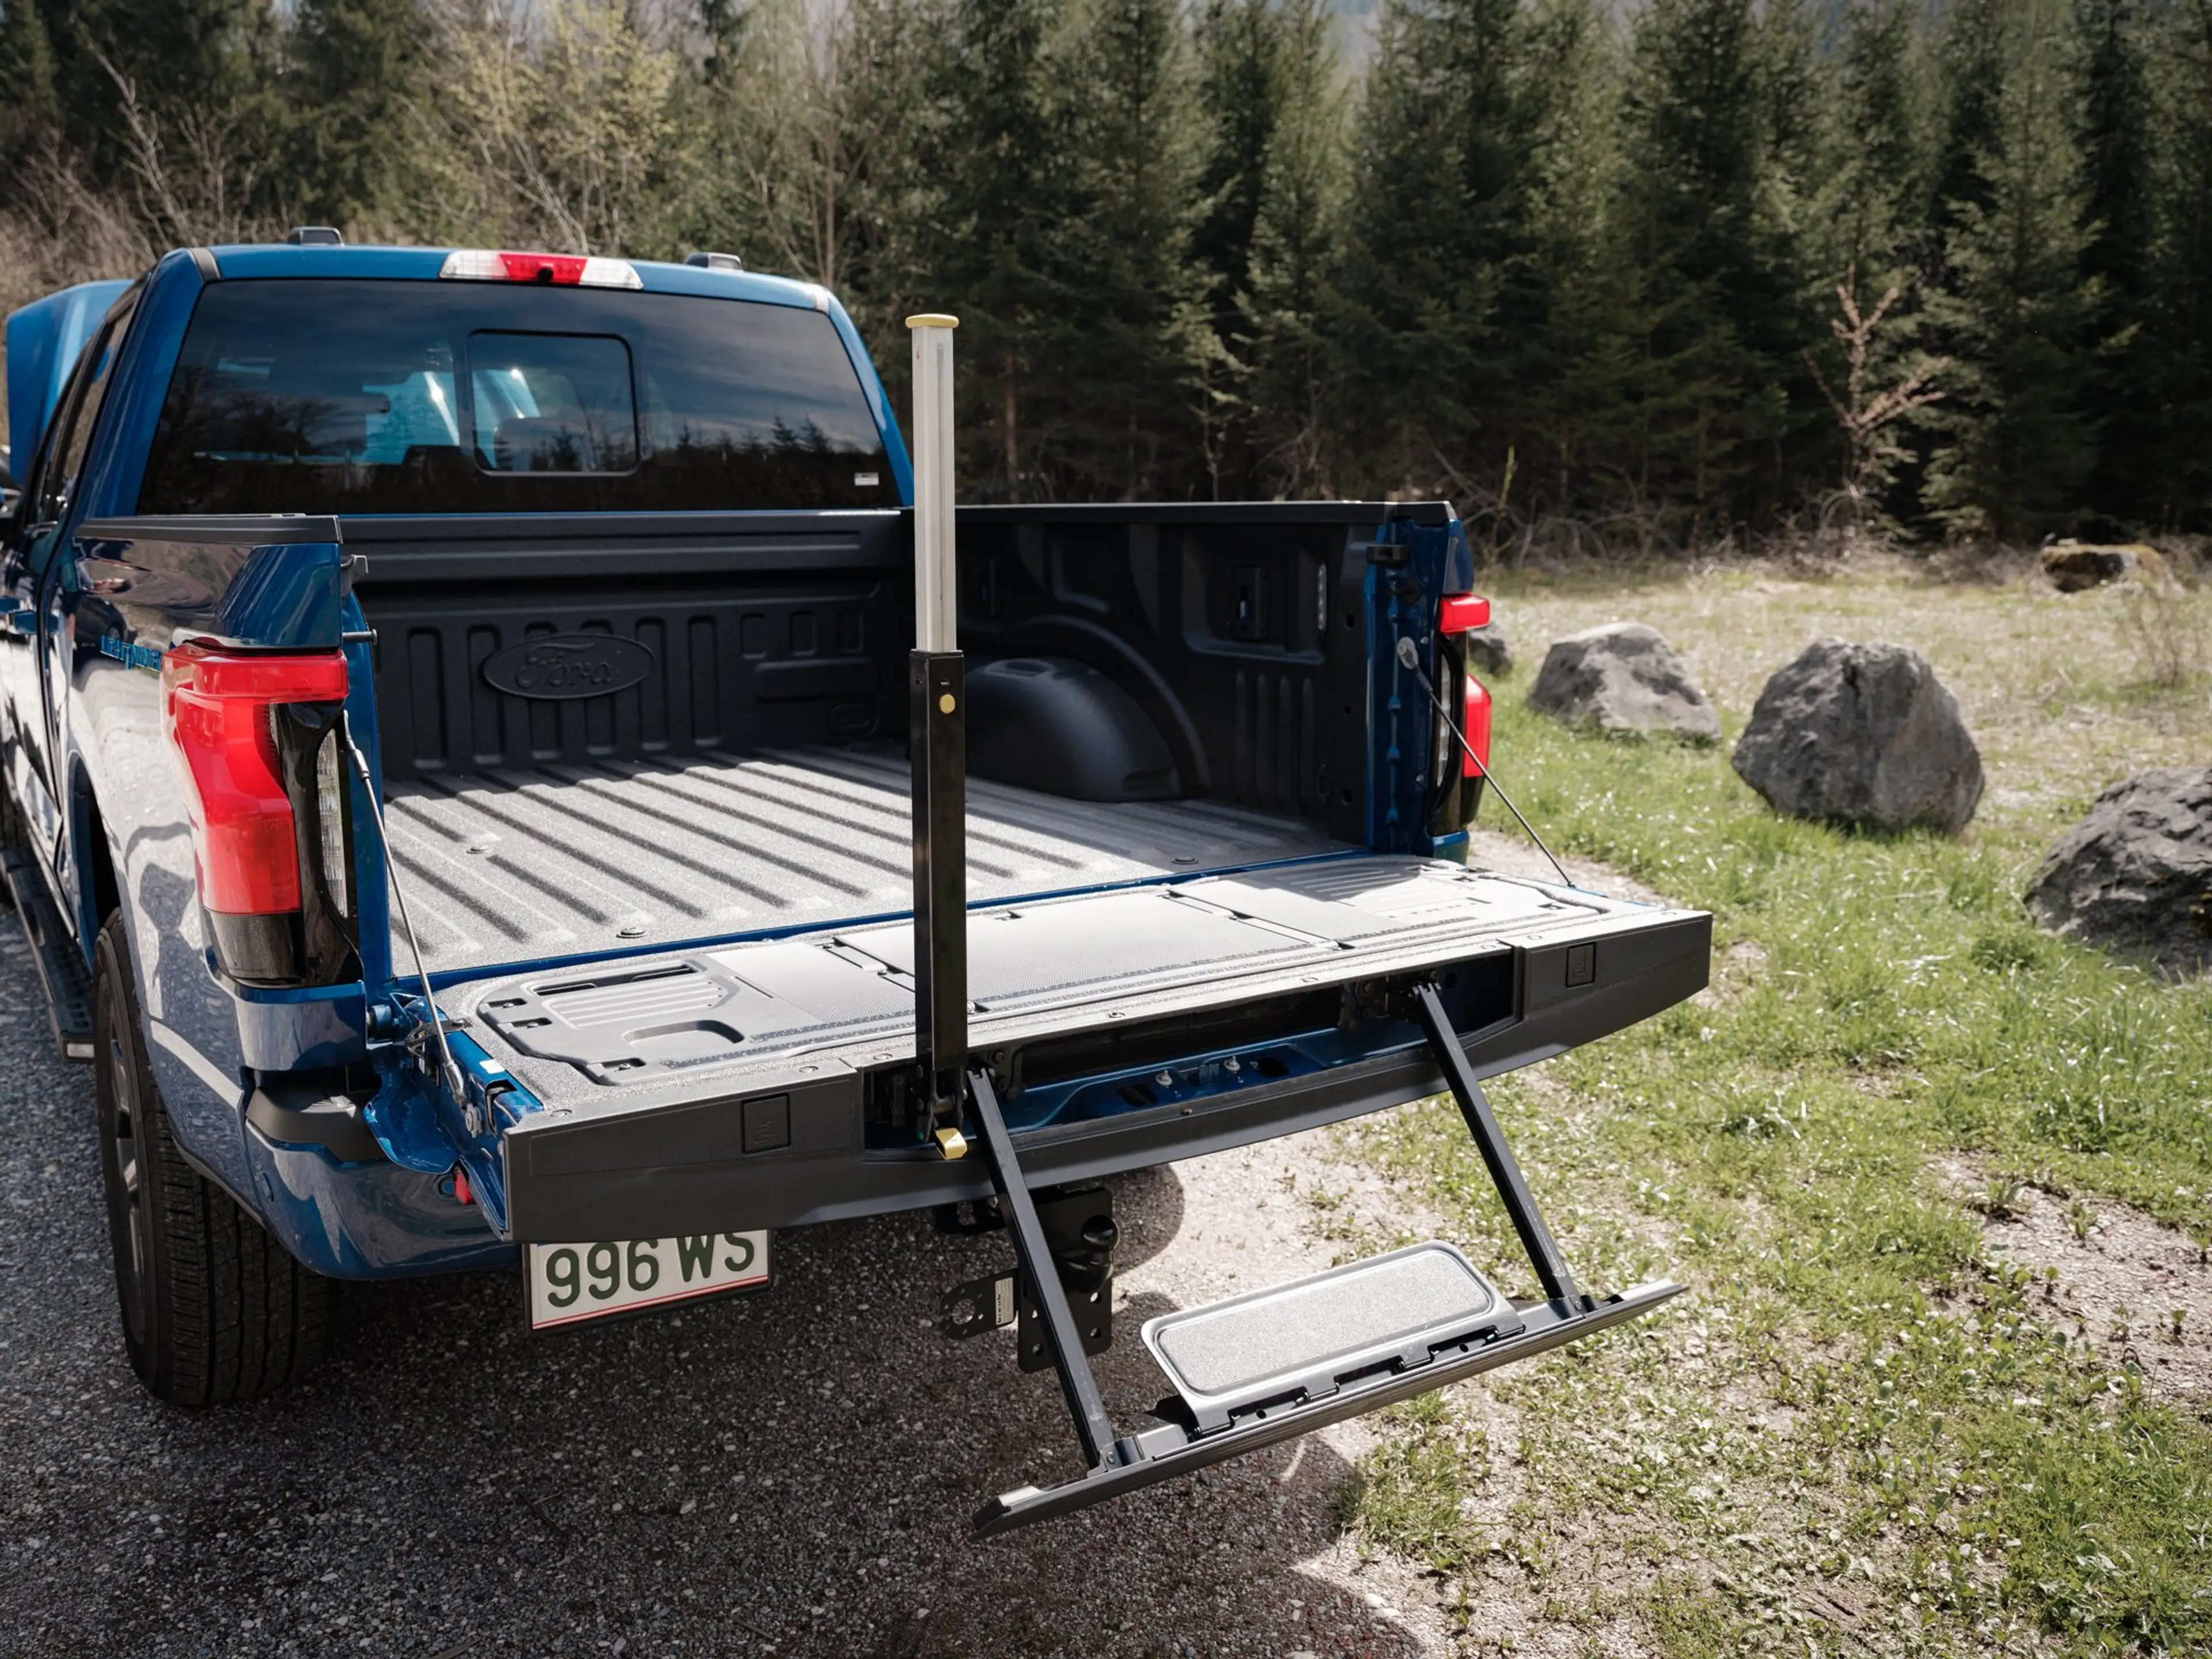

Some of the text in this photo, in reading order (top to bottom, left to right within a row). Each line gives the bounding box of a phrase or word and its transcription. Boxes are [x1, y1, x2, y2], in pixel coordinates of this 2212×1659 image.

[516, 641, 622, 689] Ford
[546, 1233, 755, 1308] 996 WS
